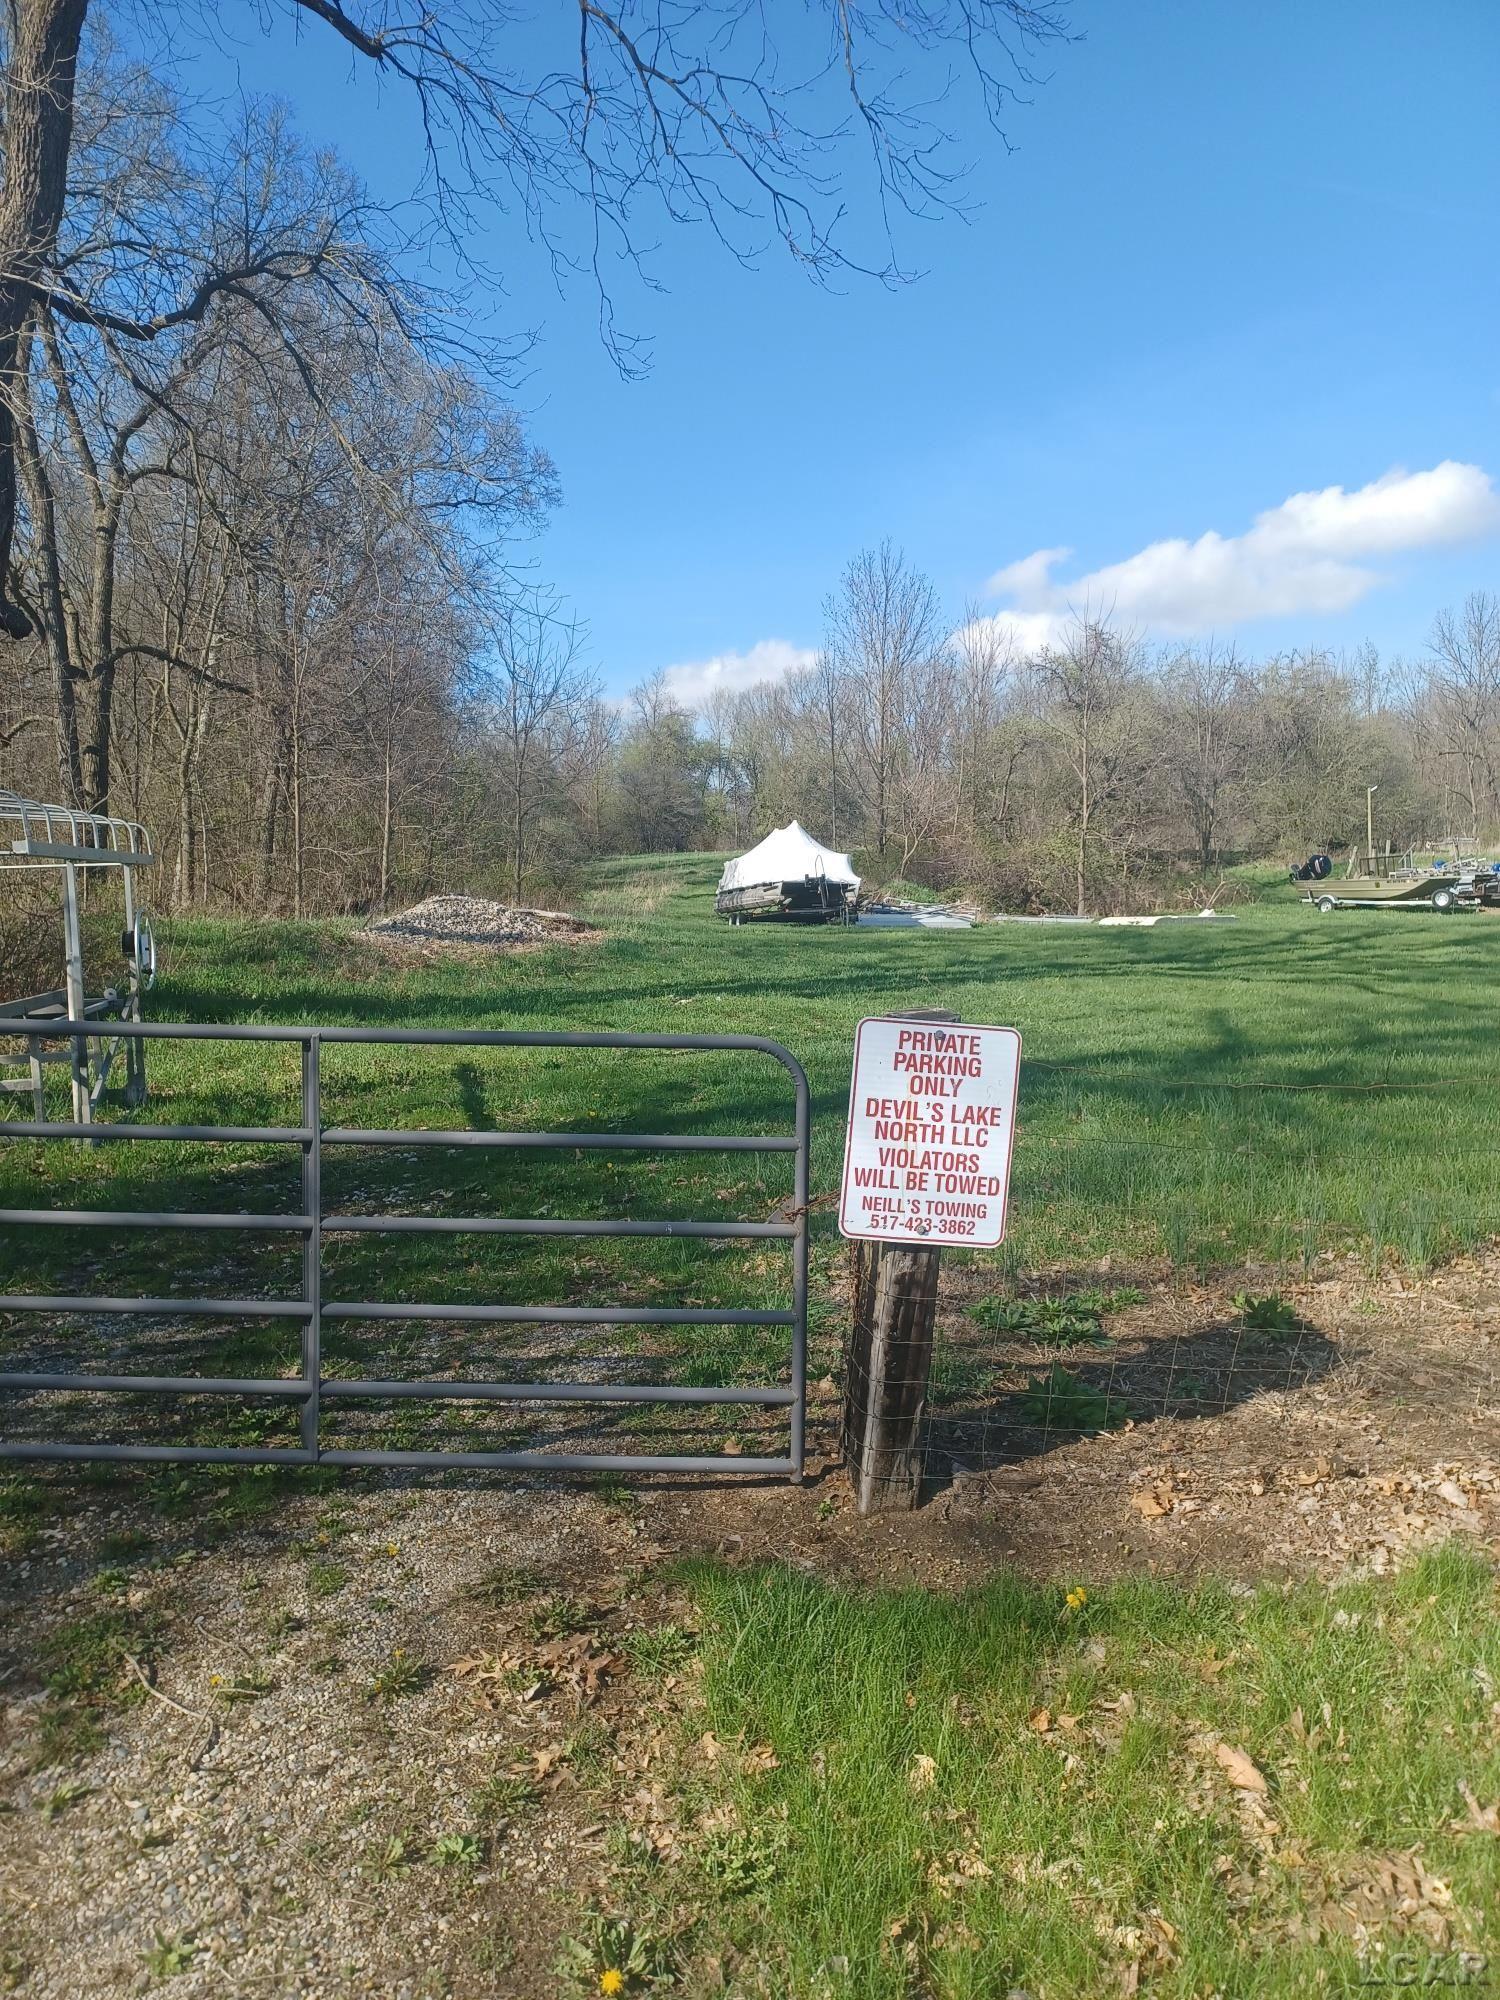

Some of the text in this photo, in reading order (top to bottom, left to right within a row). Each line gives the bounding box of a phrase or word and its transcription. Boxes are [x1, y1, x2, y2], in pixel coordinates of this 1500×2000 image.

[899, 1030, 981, 1055] PRIVATE
[894, 1052, 981, 1077] PARKING
[910, 1075, 963, 1097] ONLY
[866, 1098, 1001, 1126] DEVIL'S LAKE
[875, 1121, 988, 1147] NORTH LLC
[879, 1148, 979, 1173] VIOLATORS
[855, 1168, 999, 1196] WILL BE TOWED
[862, 1196, 986, 1218] NEILL'S TOWING
[871, 1215, 975, 1235] 517-423-3862
